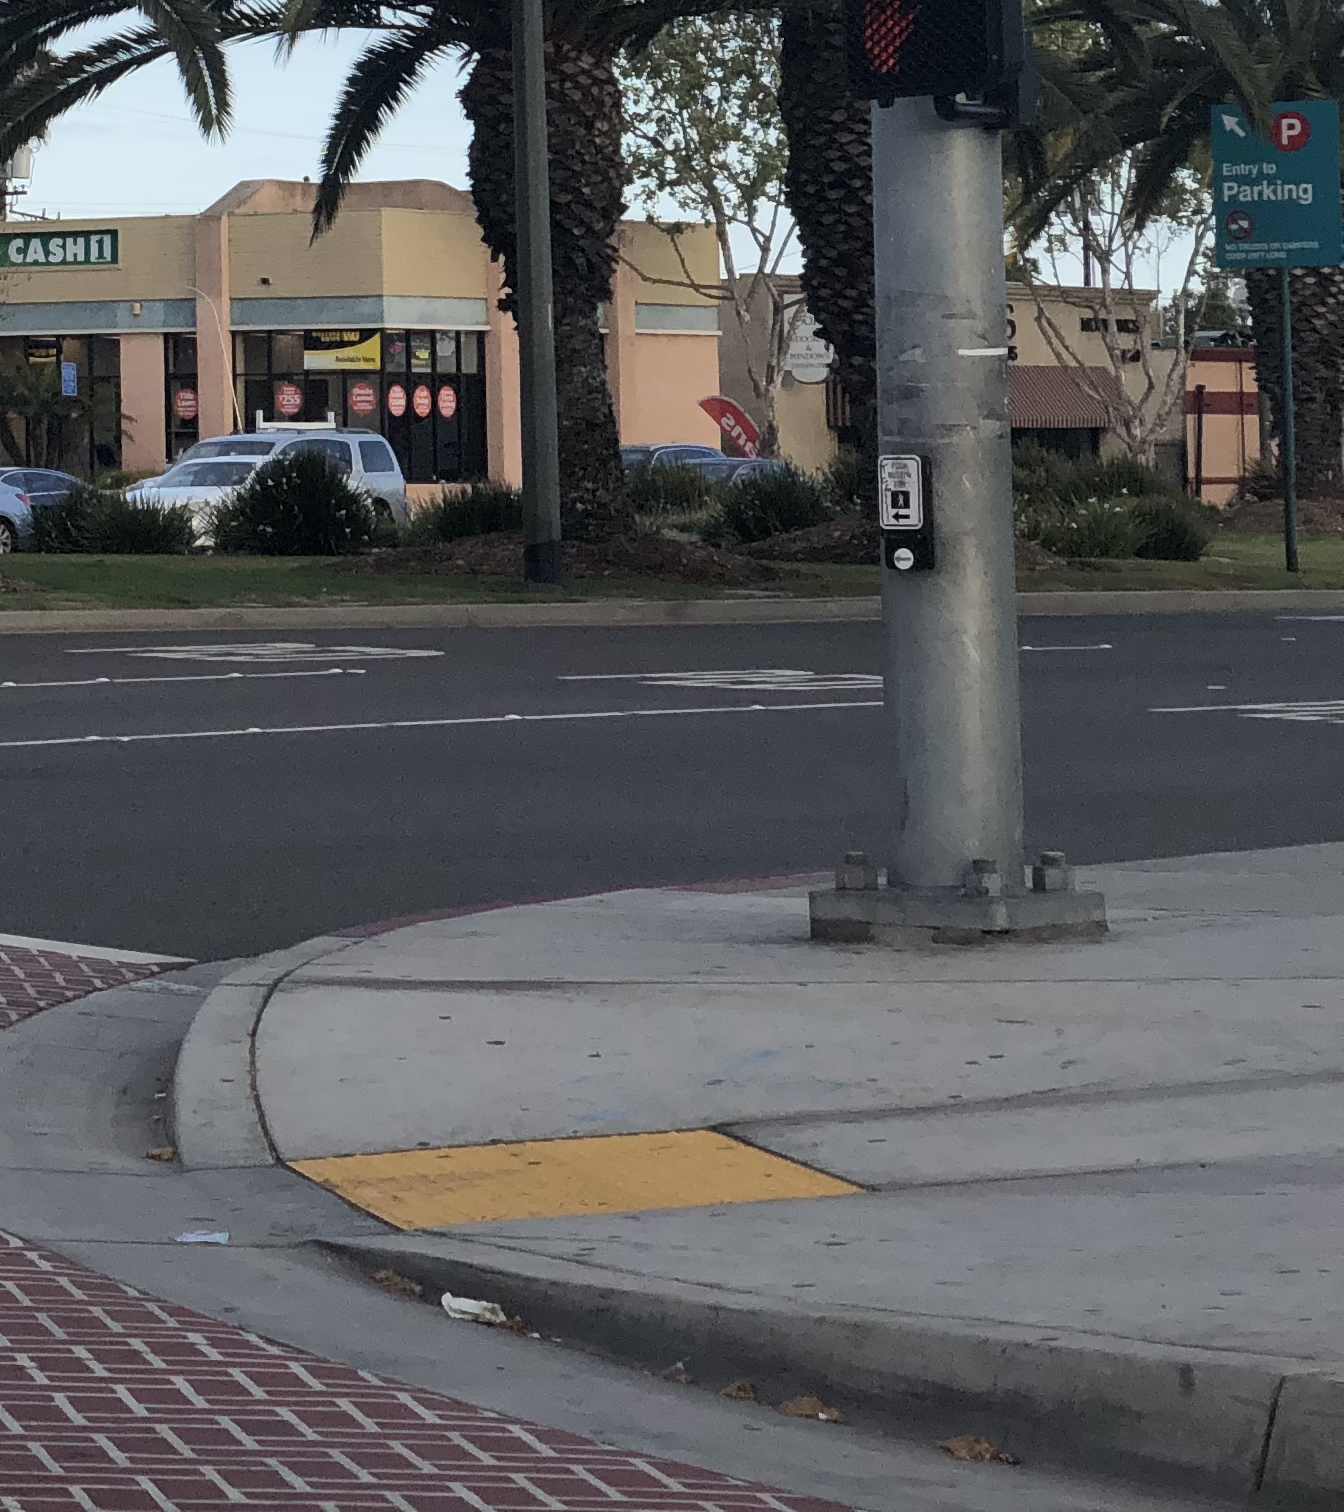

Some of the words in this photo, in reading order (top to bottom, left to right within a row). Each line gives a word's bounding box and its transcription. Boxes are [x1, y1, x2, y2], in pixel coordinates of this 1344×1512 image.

[1281, 118, 1302, 145] P
[1222, 163, 1259, 178] Entry
[1263, 162, 1277, 175] to
[1222, 180, 1313, 205] Parking
[8, 236, 85, 263] CASH
